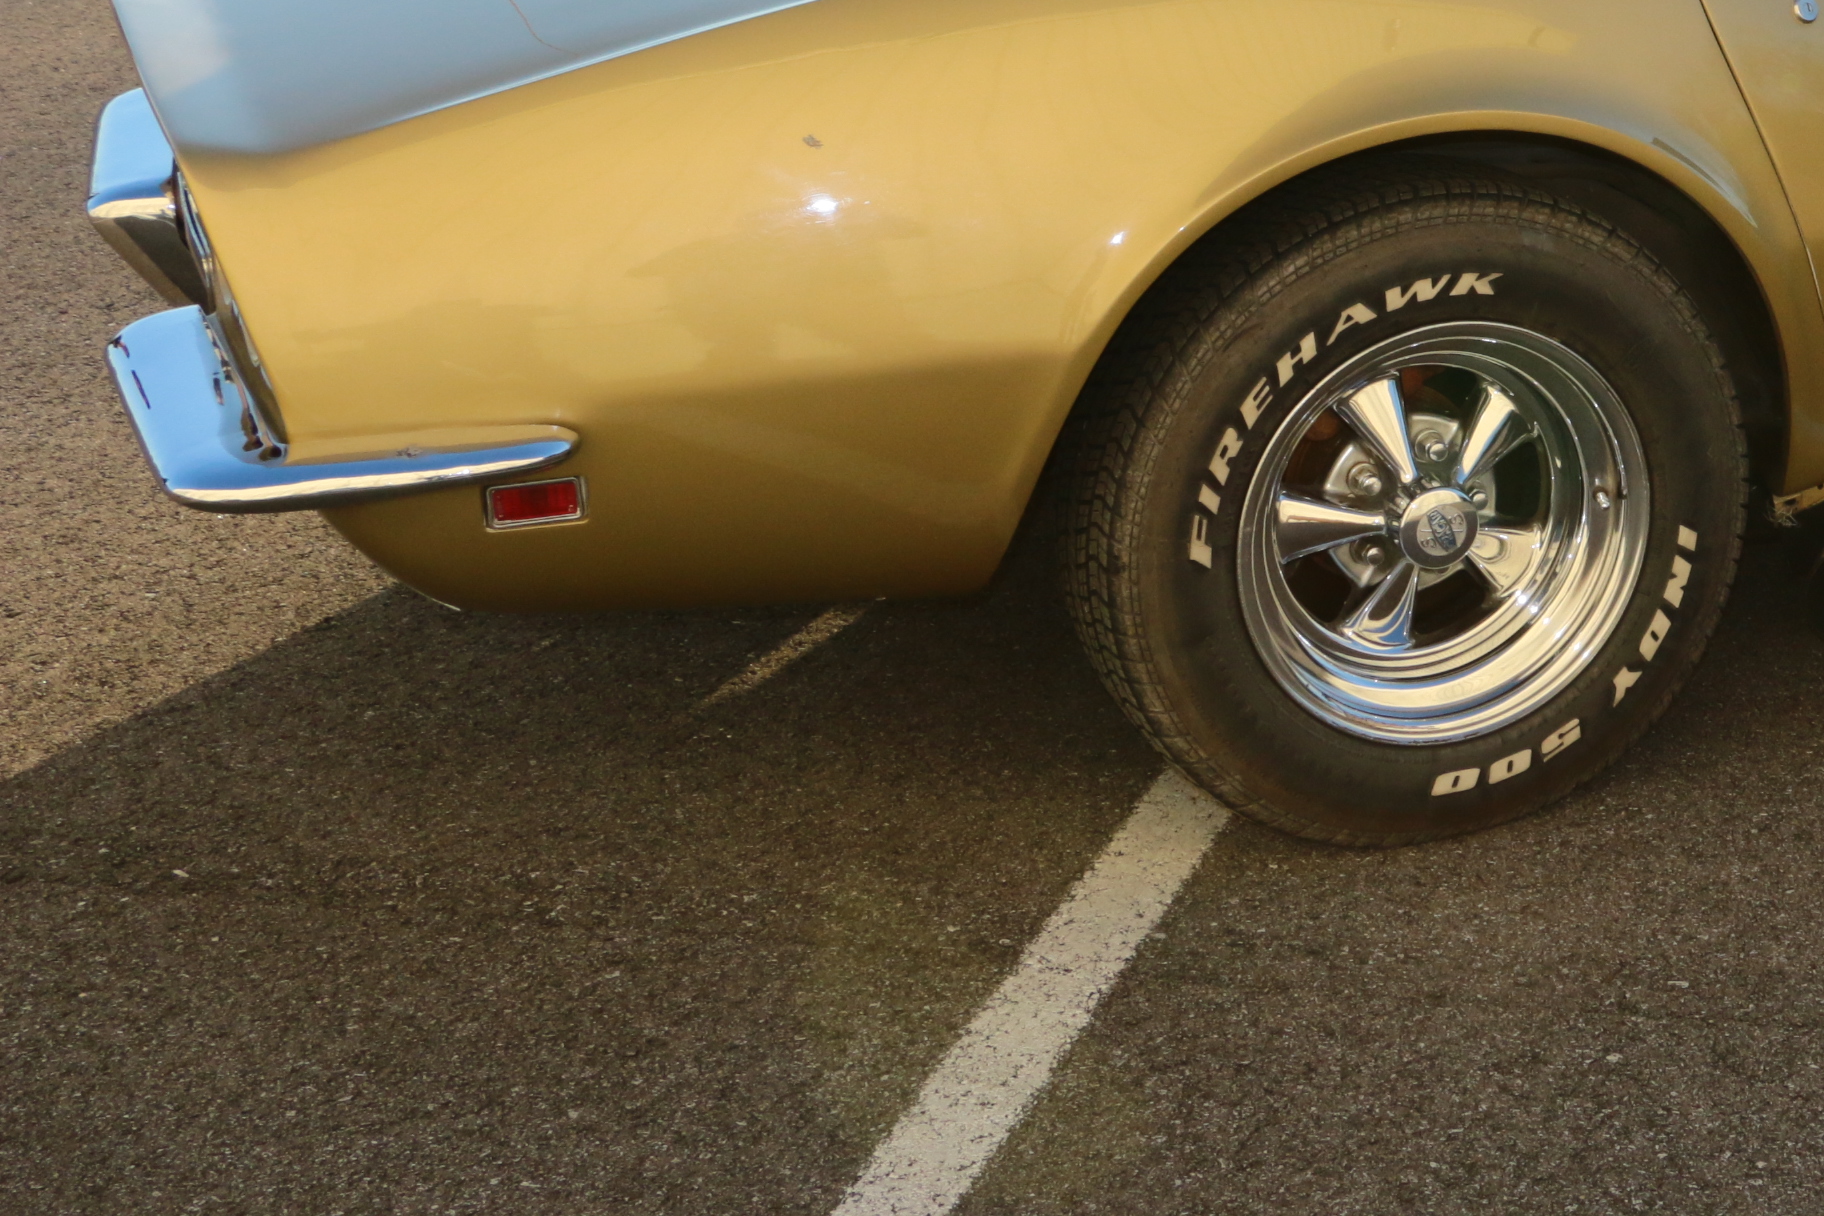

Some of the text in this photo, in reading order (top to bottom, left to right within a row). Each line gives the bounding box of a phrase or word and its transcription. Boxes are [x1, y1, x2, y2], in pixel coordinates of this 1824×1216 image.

[1189, 272, 1504, 570] FIREHAWK
[1430, 524, 1698, 798] INDY 500
